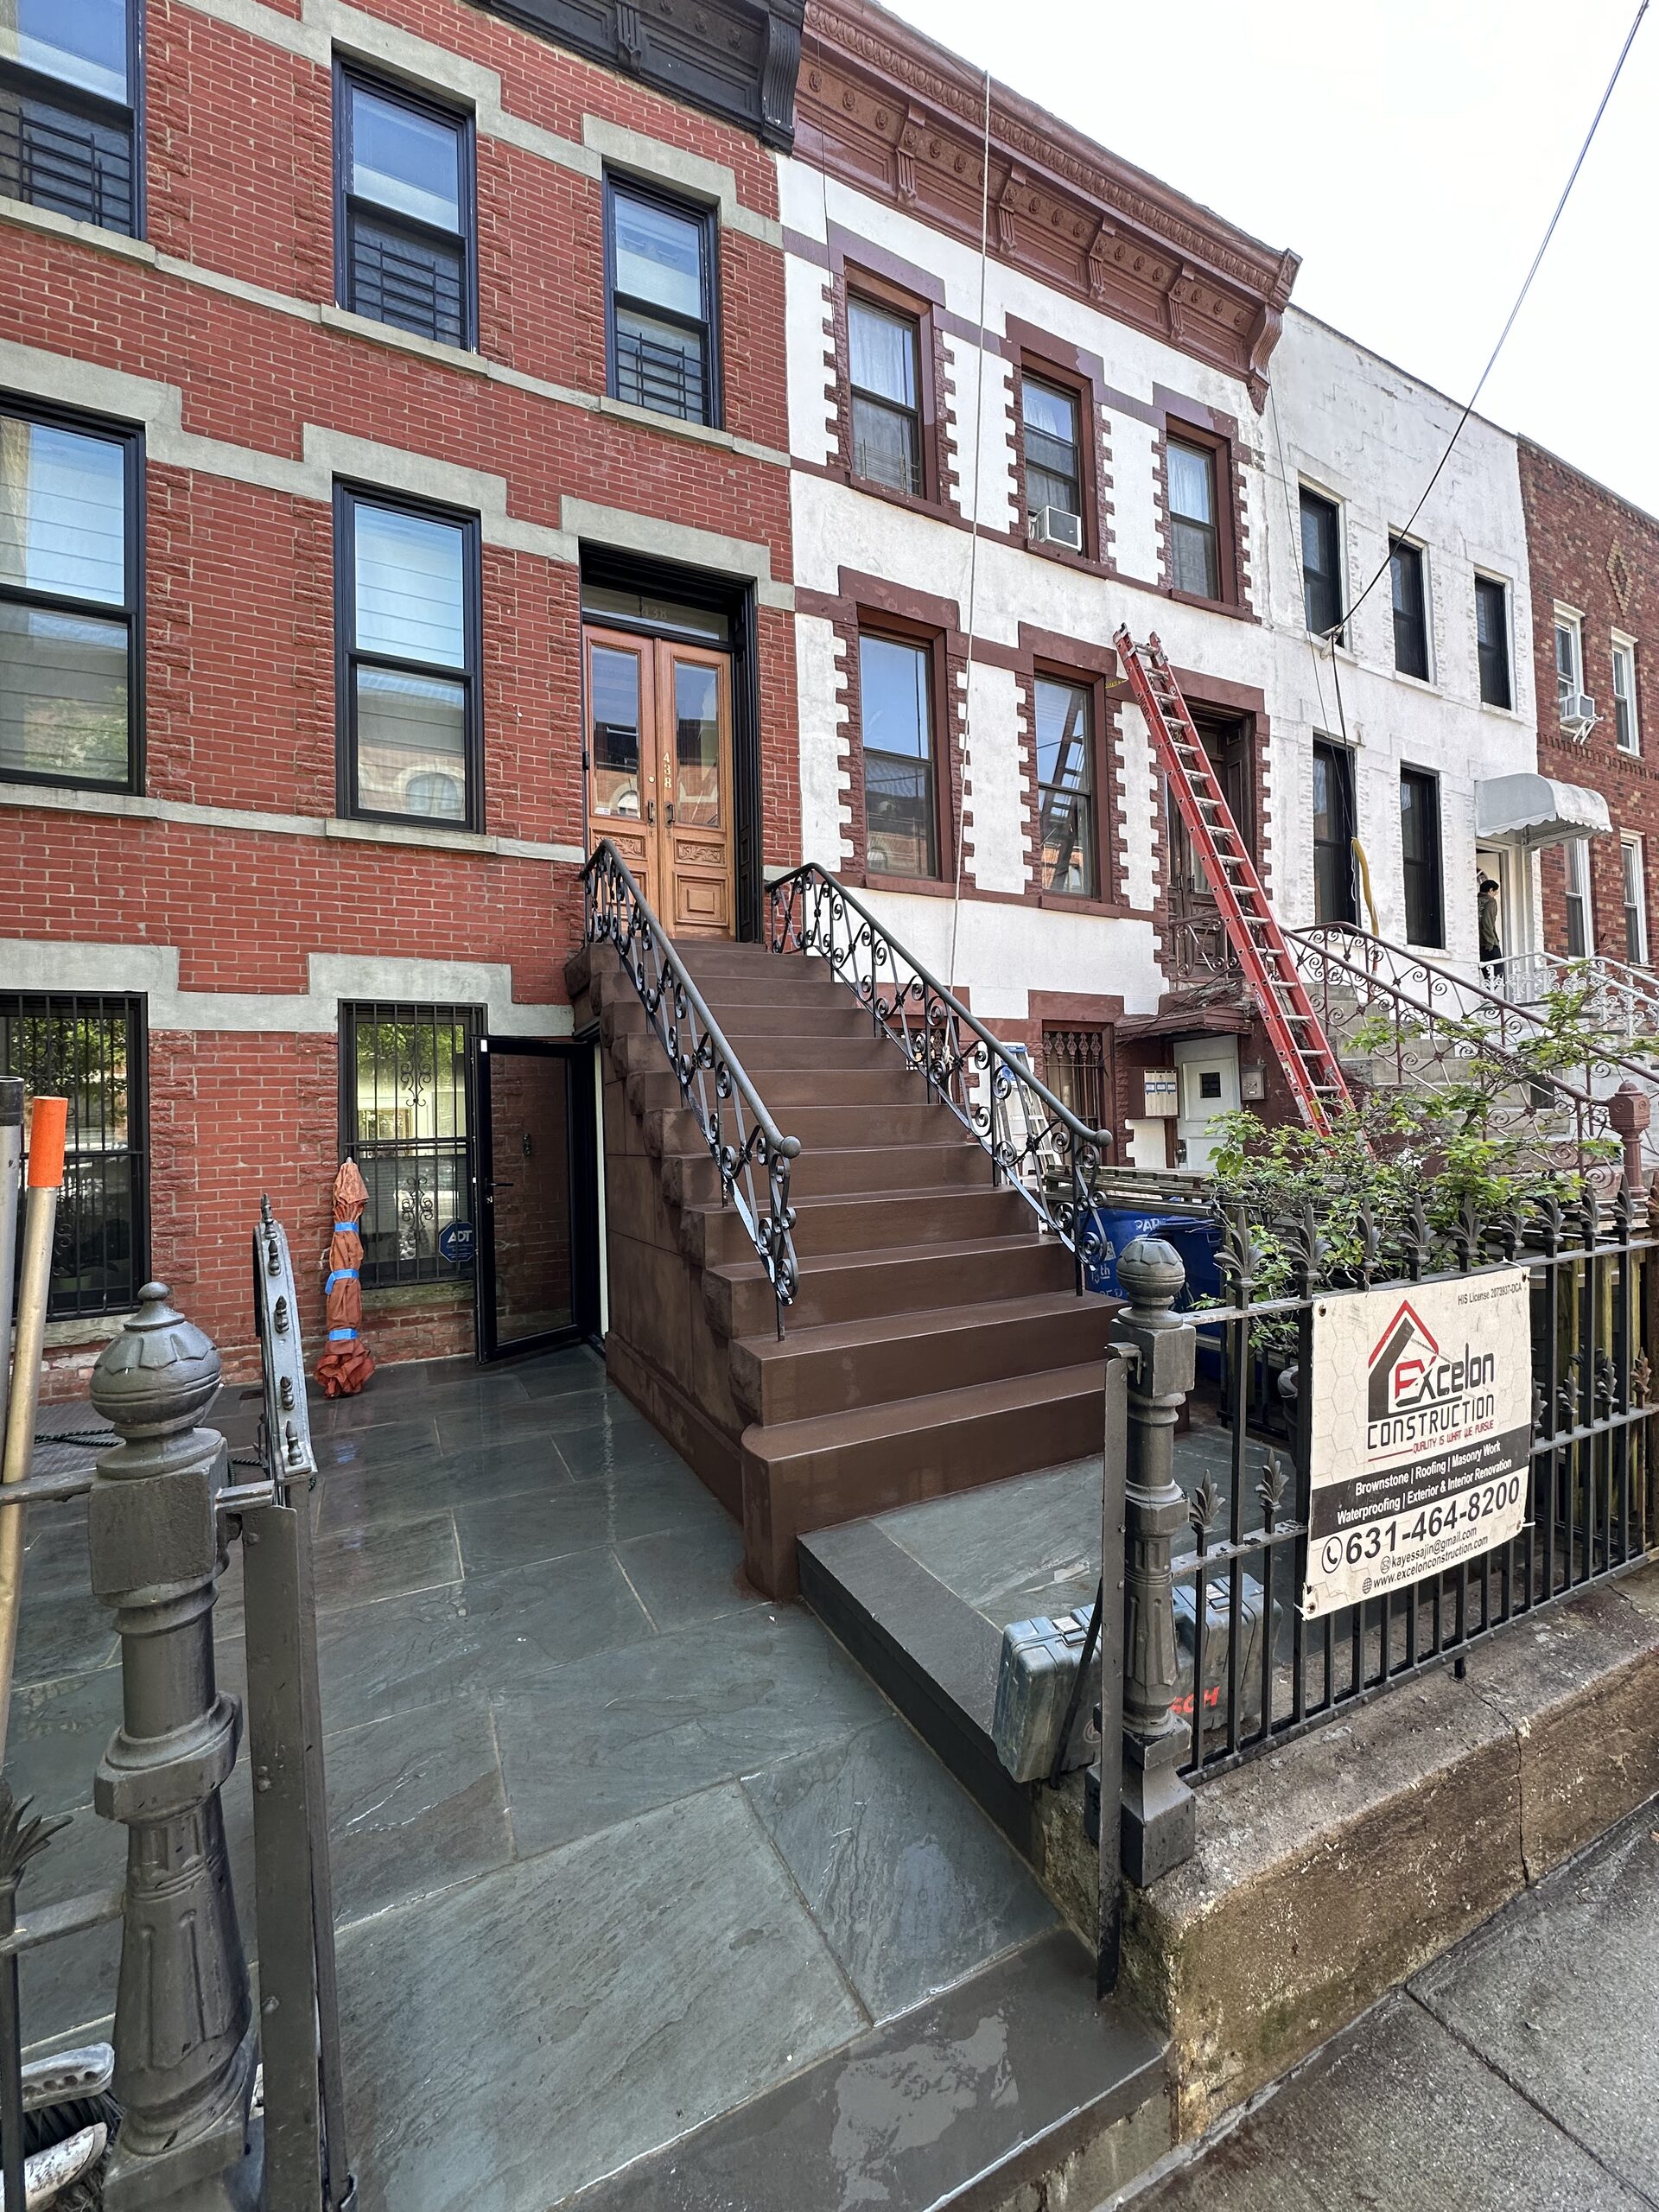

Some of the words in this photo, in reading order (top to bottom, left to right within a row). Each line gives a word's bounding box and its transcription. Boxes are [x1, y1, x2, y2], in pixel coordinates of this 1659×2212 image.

[447, 1230, 473, 1243] ADT
[1469, 1292, 1490, 1304] License
[1368, 1394, 1494, 1450] CONSTRUCTION
[1413, 1438, 1437, 1454] QUALITY
[1439, 1436, 1445, 1446] IS
[1446, 1430, 1462, 1443] WHAT
[1464, 1427, 1472, 1439] WE
[1475, 1420, 1495, 1434] PURSUE
[1337, 1497, 1401, 1525] Waterproofing
[1407, 1484, 1439, 1503] Exterior
[1440, 1479, 1446, 1493] &
[1447, 1472, 1474, 1491] Interior
[1475, 1458, 1512, 1481] Renovation
[1355, 1471, 1409, 1497] Brownstone
[1415, 1462, 1446, 1479] Roofing
[1452, 1448, 1482, 1468] Masonry
[1483, 1440, 1501, 1457] Work
[1345, 1476, 1520, 1565] 631-464-8200
[1373, 1535, 1489, 1589] www.excelonconstruction.com
[1391, 1527, 1478, 1568] kayessajin@gmail.com
[1170, 1686, 1220, 1715] SCH
